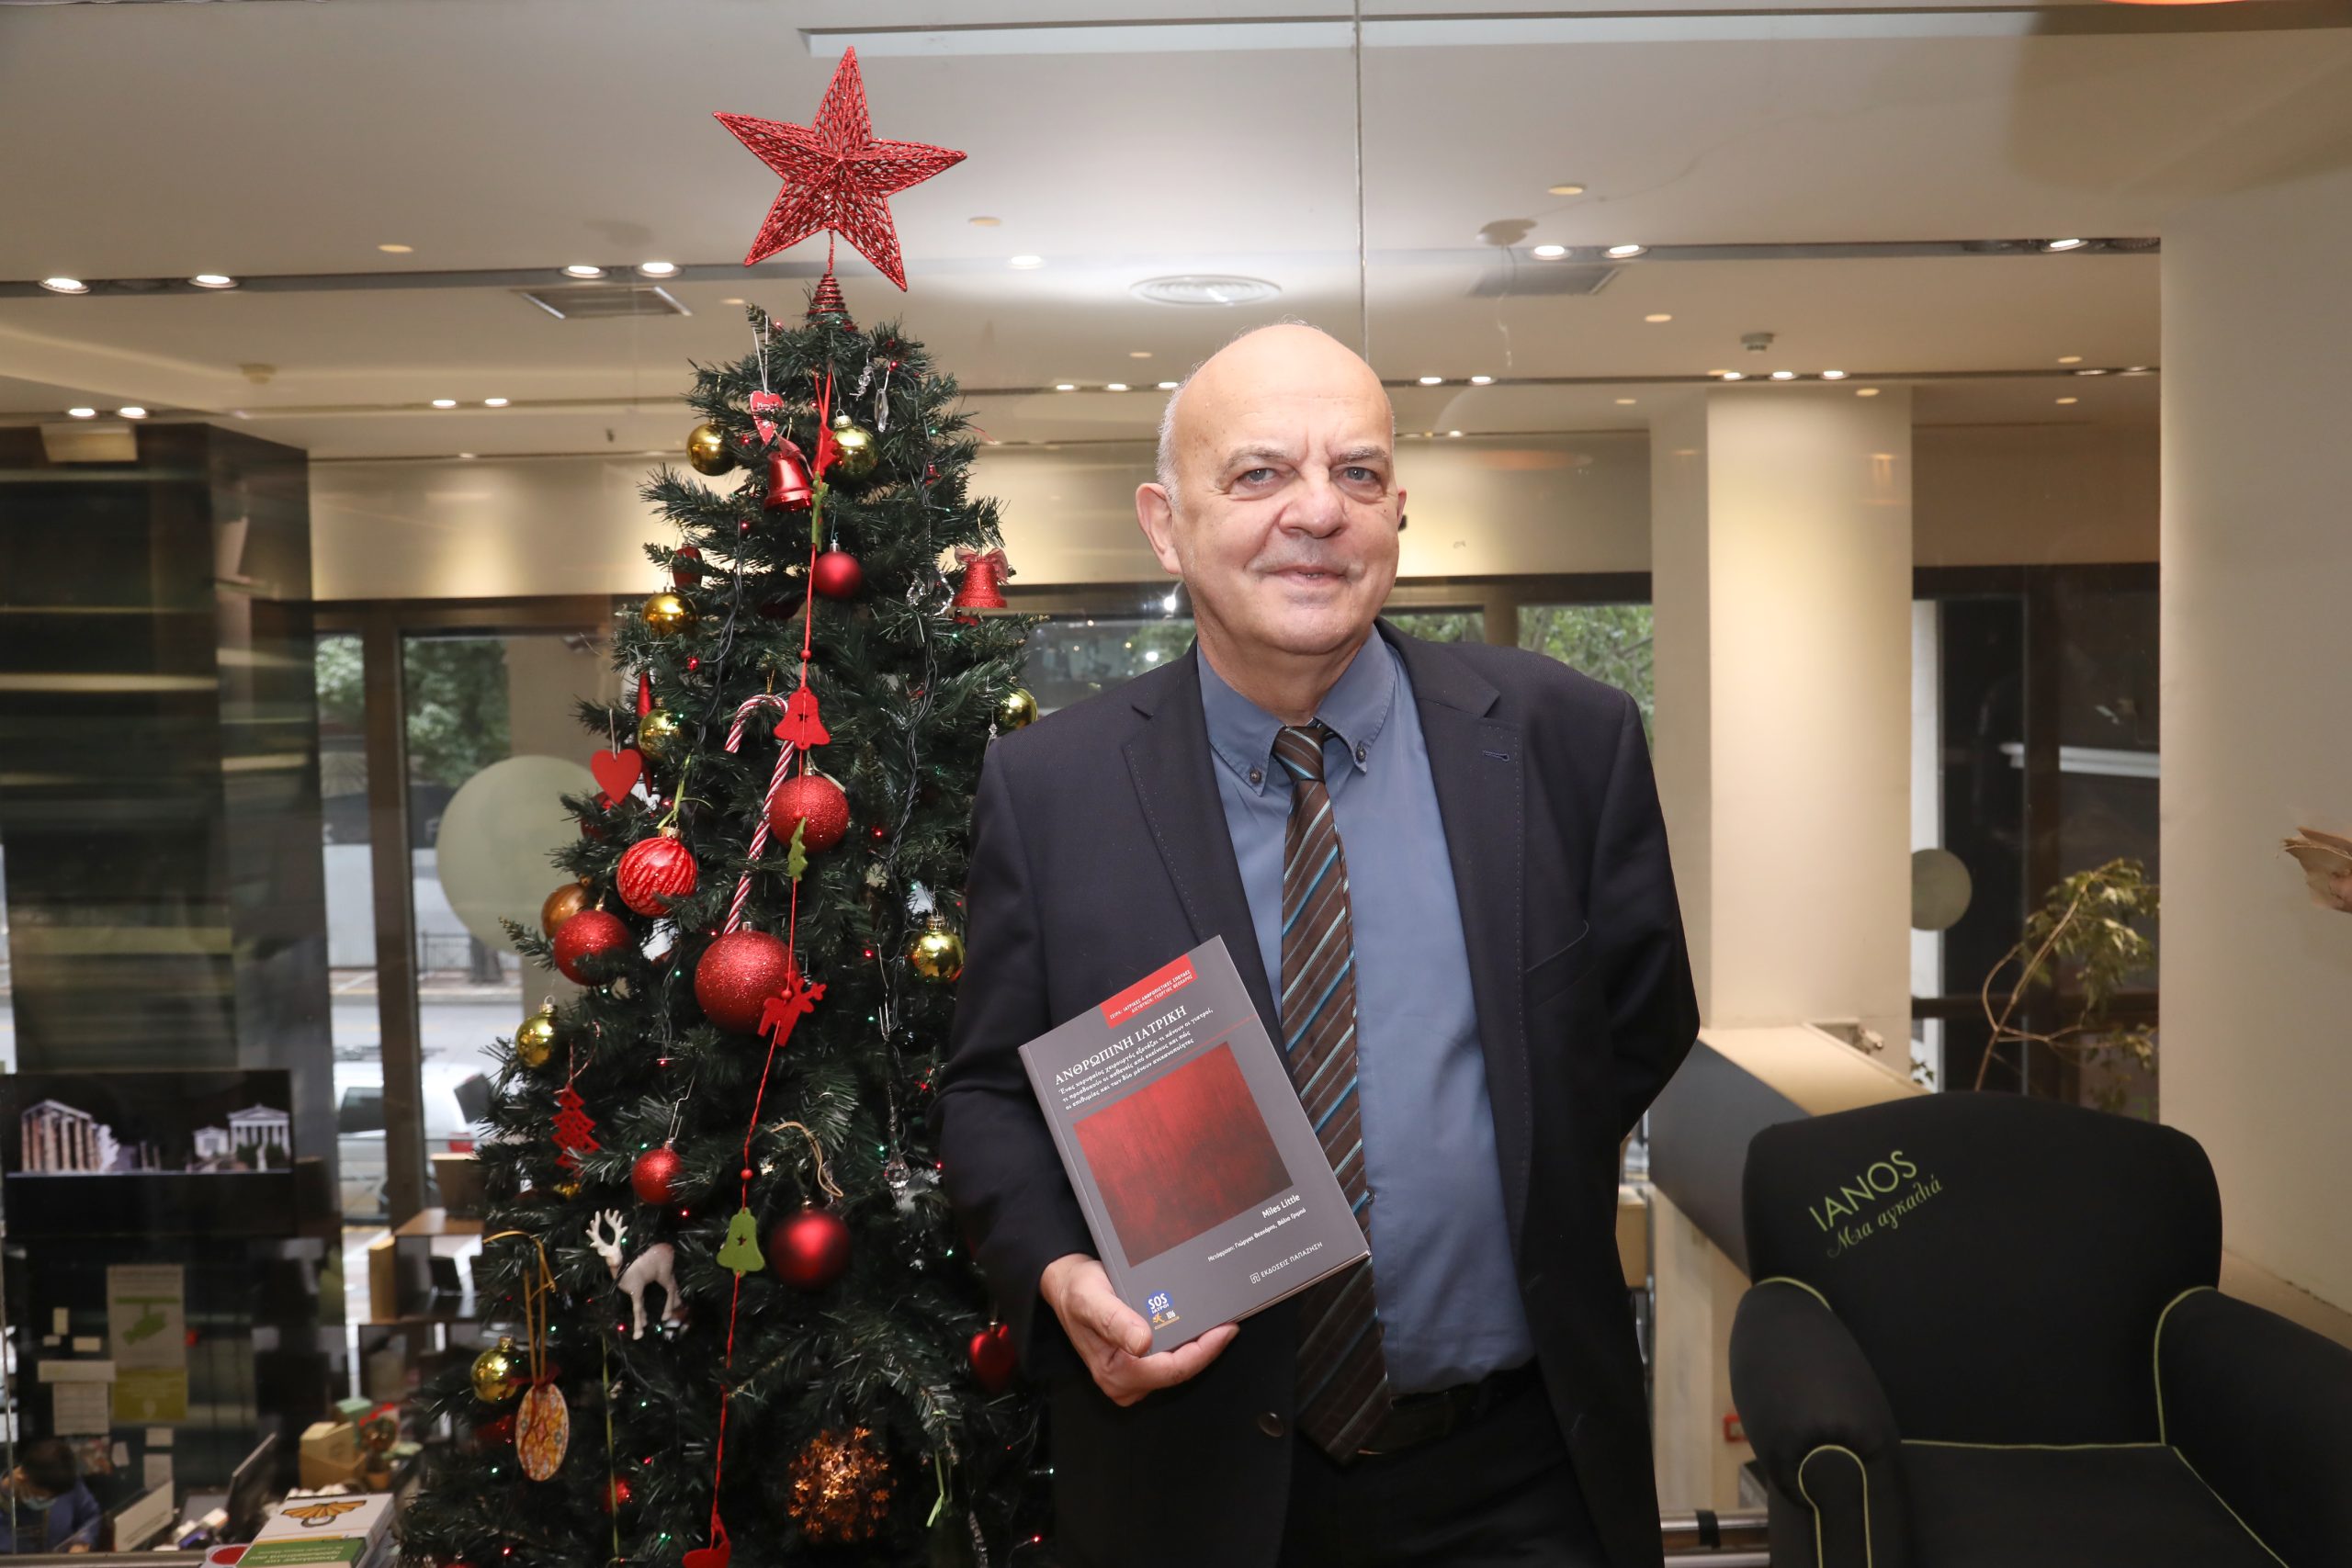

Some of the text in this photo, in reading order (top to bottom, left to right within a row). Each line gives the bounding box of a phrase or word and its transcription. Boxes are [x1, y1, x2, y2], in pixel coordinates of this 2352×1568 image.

[1056, 1005, 1187, 1085] ΑΝΘΡΩΠΙΝΗ ΙΑΤΡΙΚΗ
[1261, 1195, 1300, 1218] Miles Little
[1809, 1150, 1917, 1232] IANOS
[1826, 1174, 1943, 1258] Μια αγκαλιά
[1261, 1242, 1323, 1278] ΕΚΔΟΣΕΙΣ ΠΑΠΑΖΗΣΗ
[1148, 1292, 1168, 1310] SOS
